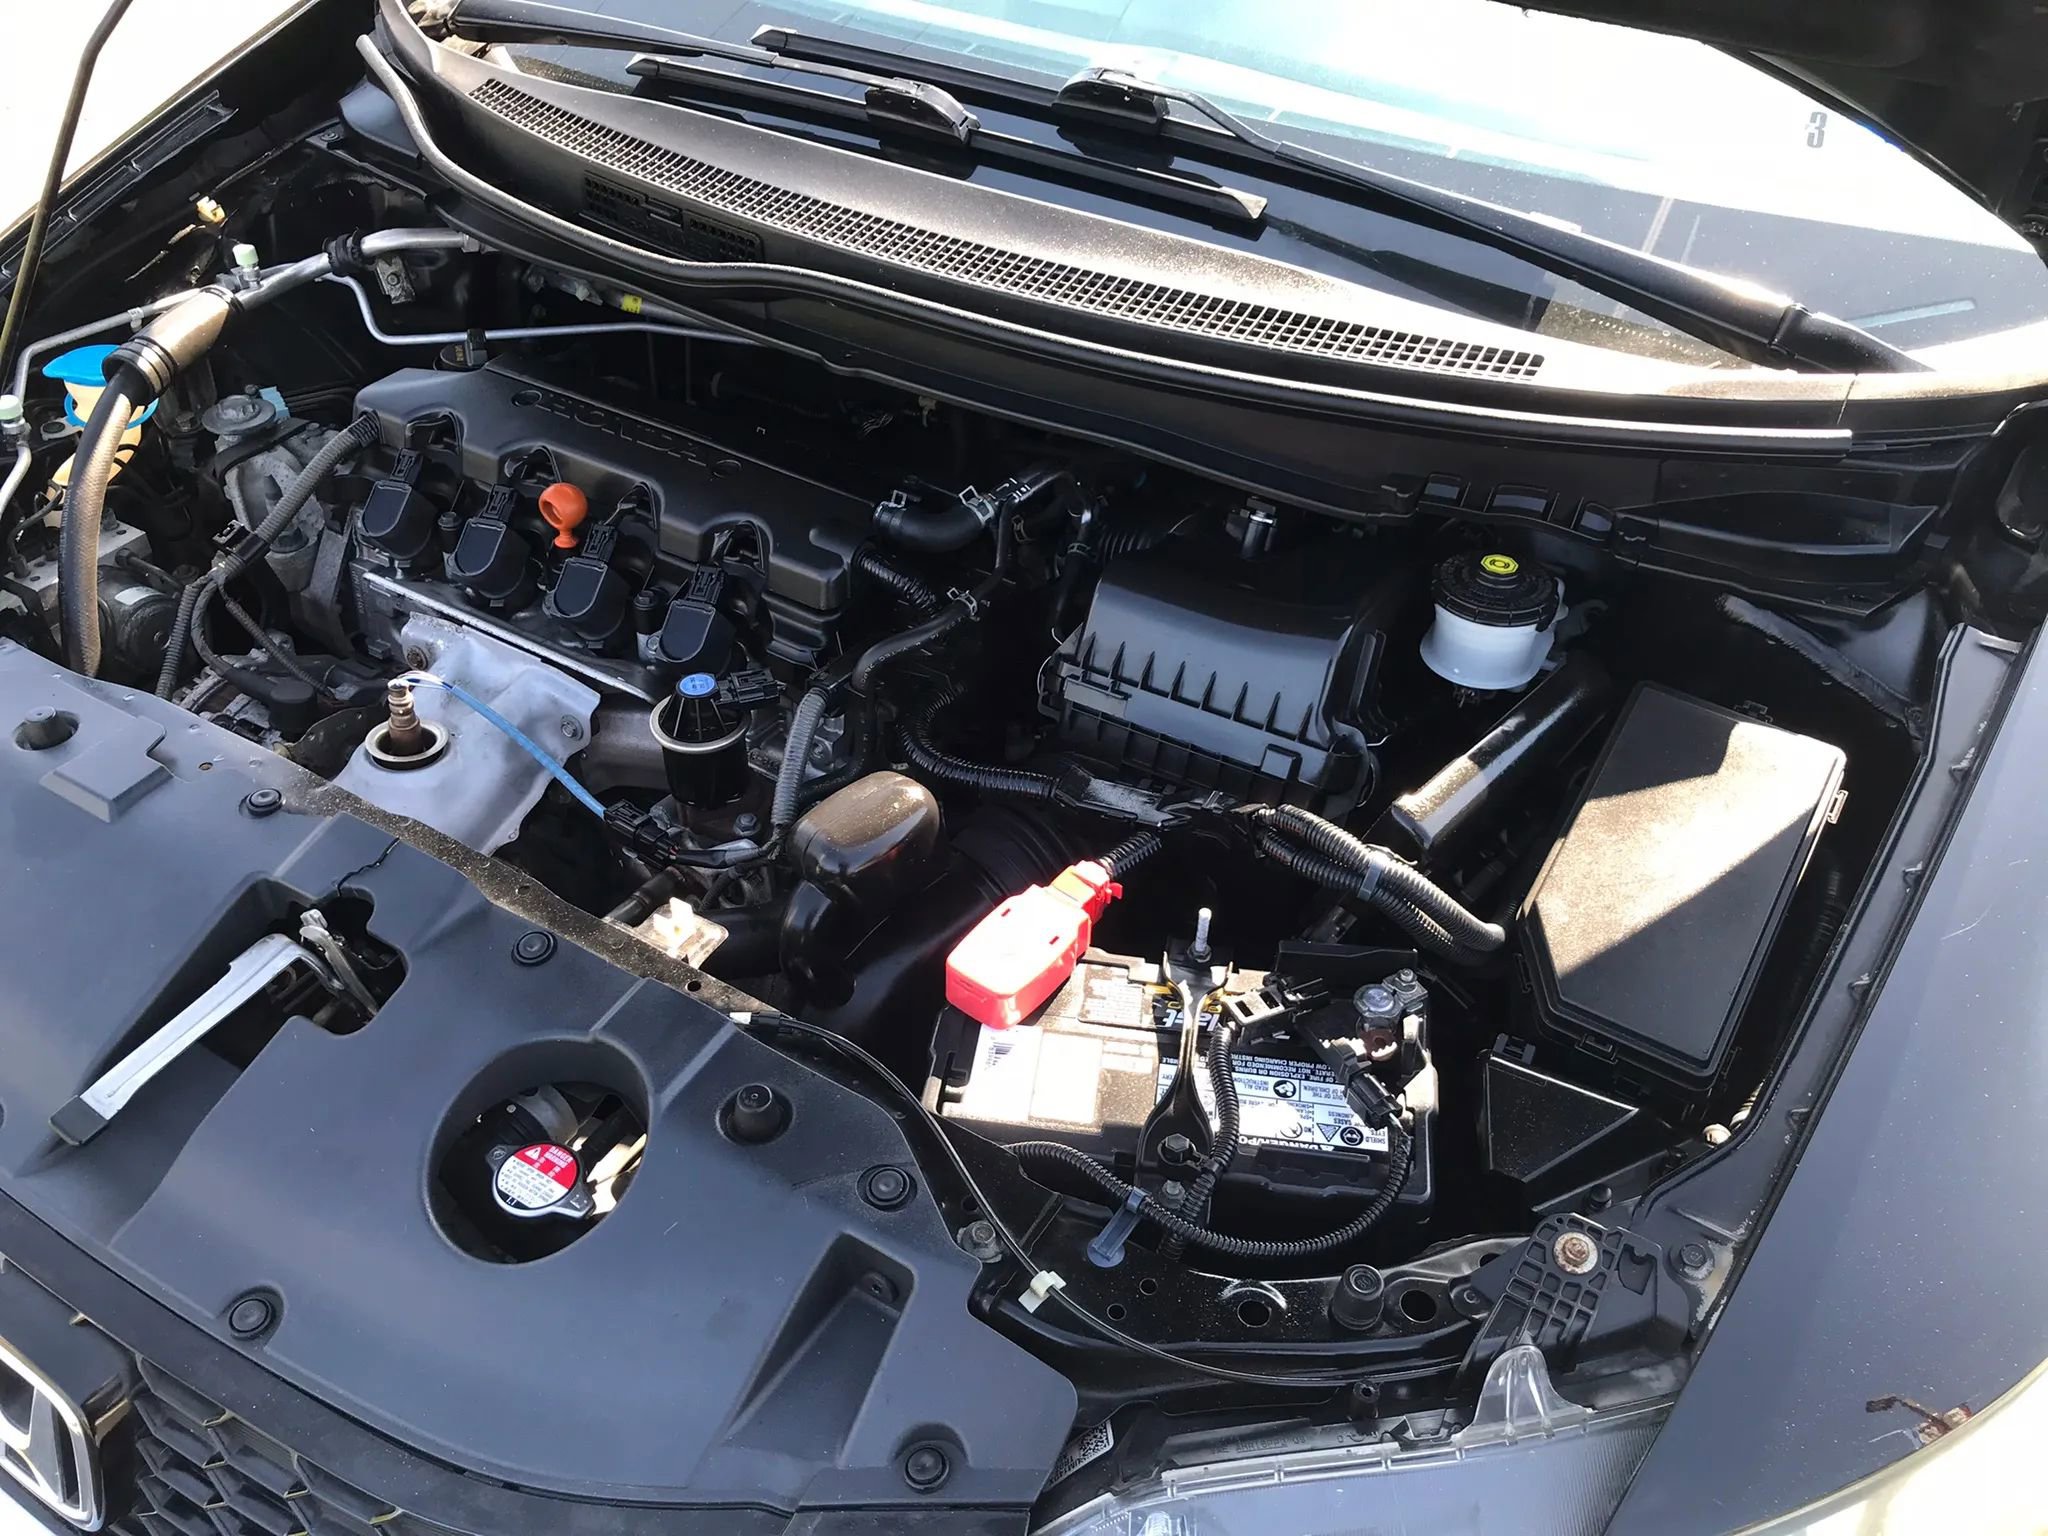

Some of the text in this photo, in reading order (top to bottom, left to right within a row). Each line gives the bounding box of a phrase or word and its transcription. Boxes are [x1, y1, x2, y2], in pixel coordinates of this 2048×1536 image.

[1807, 112, 1827, 148] 3
[1246, 1062, 1297, 1072] RECOMMENDED
[1269, 1069, 1306, 1080] EXPLOSION
[1365, 1136, 1386, 1145] SHIELD
[549, 1146, 574, 1162] DANGER
